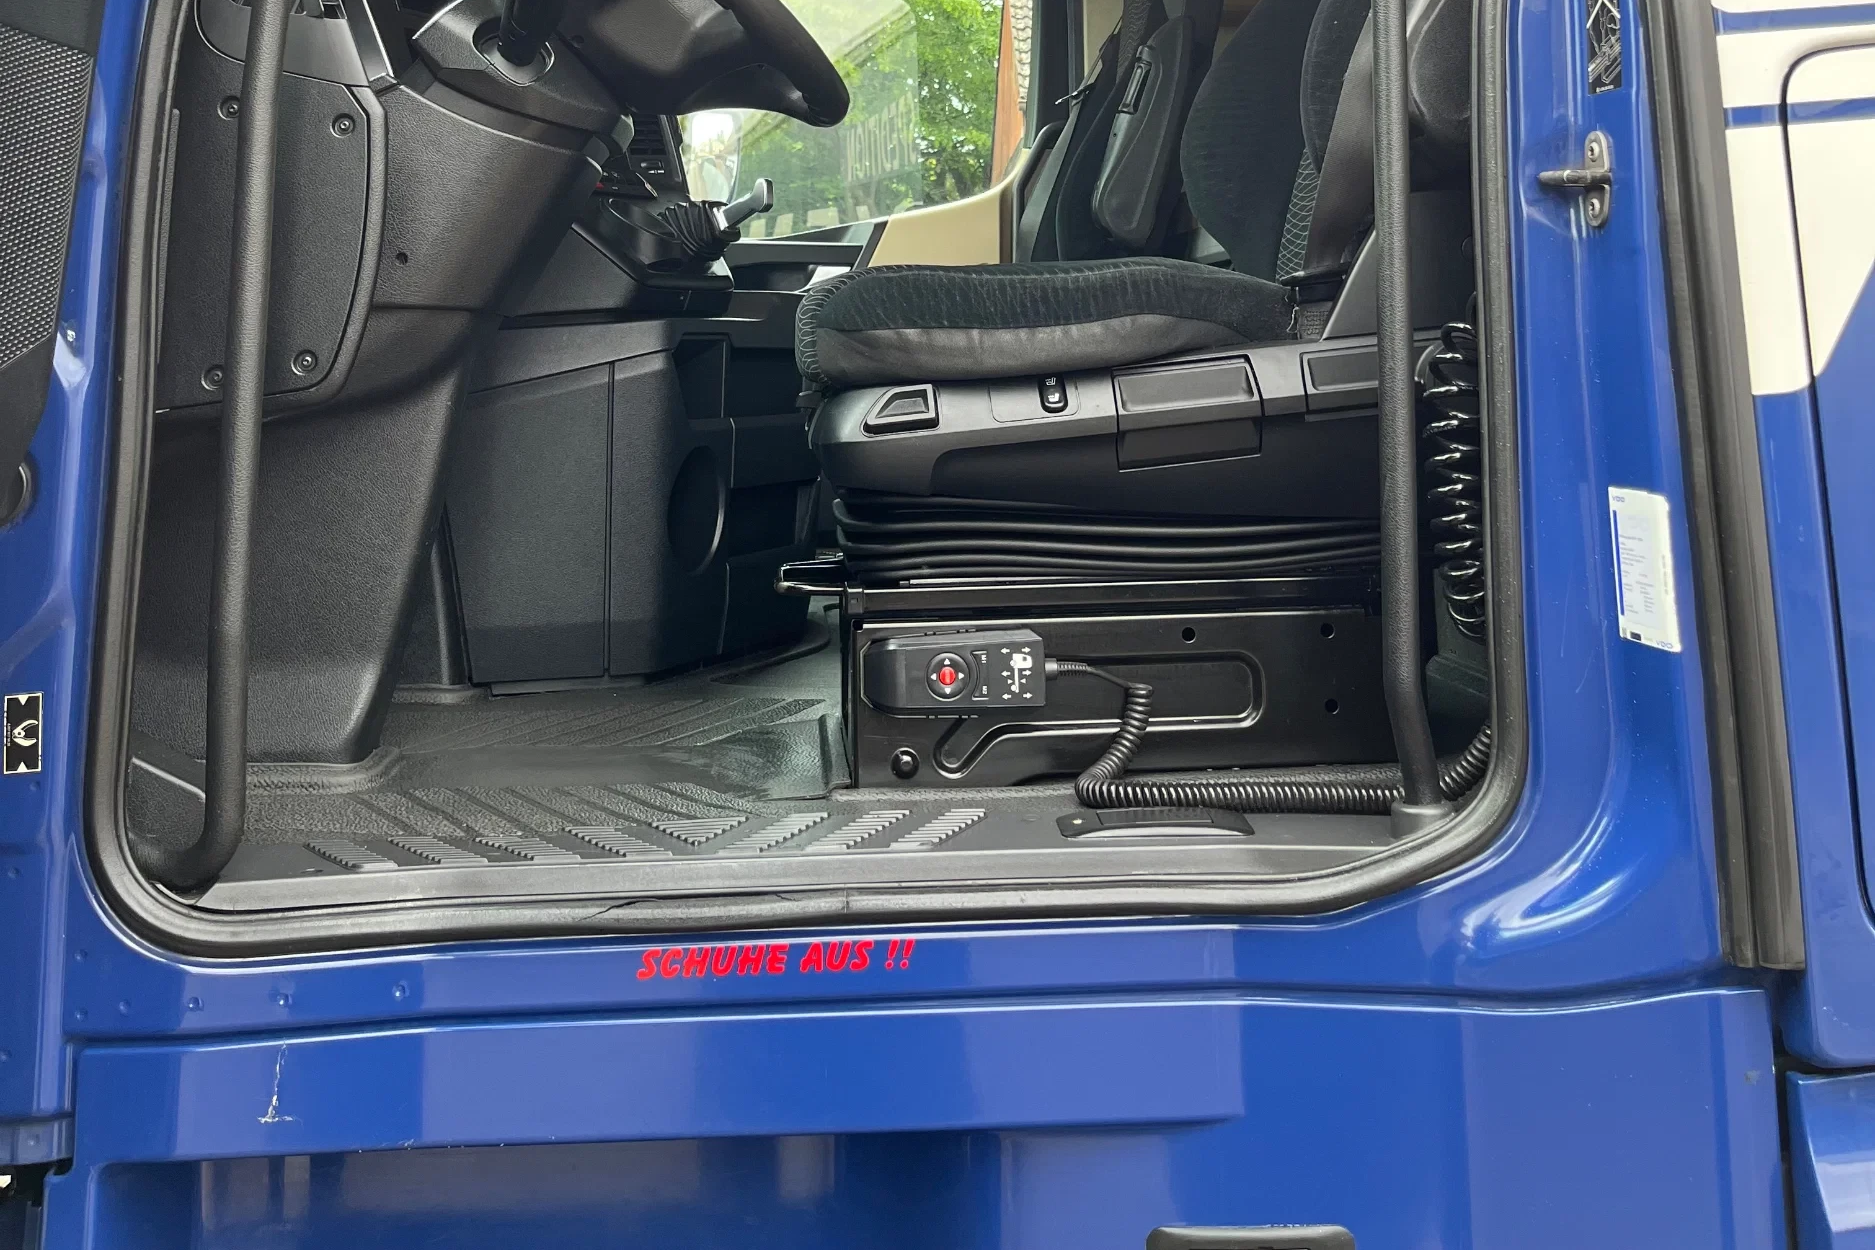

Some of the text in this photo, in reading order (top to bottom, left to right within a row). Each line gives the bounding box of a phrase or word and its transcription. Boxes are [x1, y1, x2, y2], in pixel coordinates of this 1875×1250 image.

[981, 654, 987, 664] M1
[982, 685, 988, 694] M2
[636, 938, 915, 980] SCHUHE AUS !!
